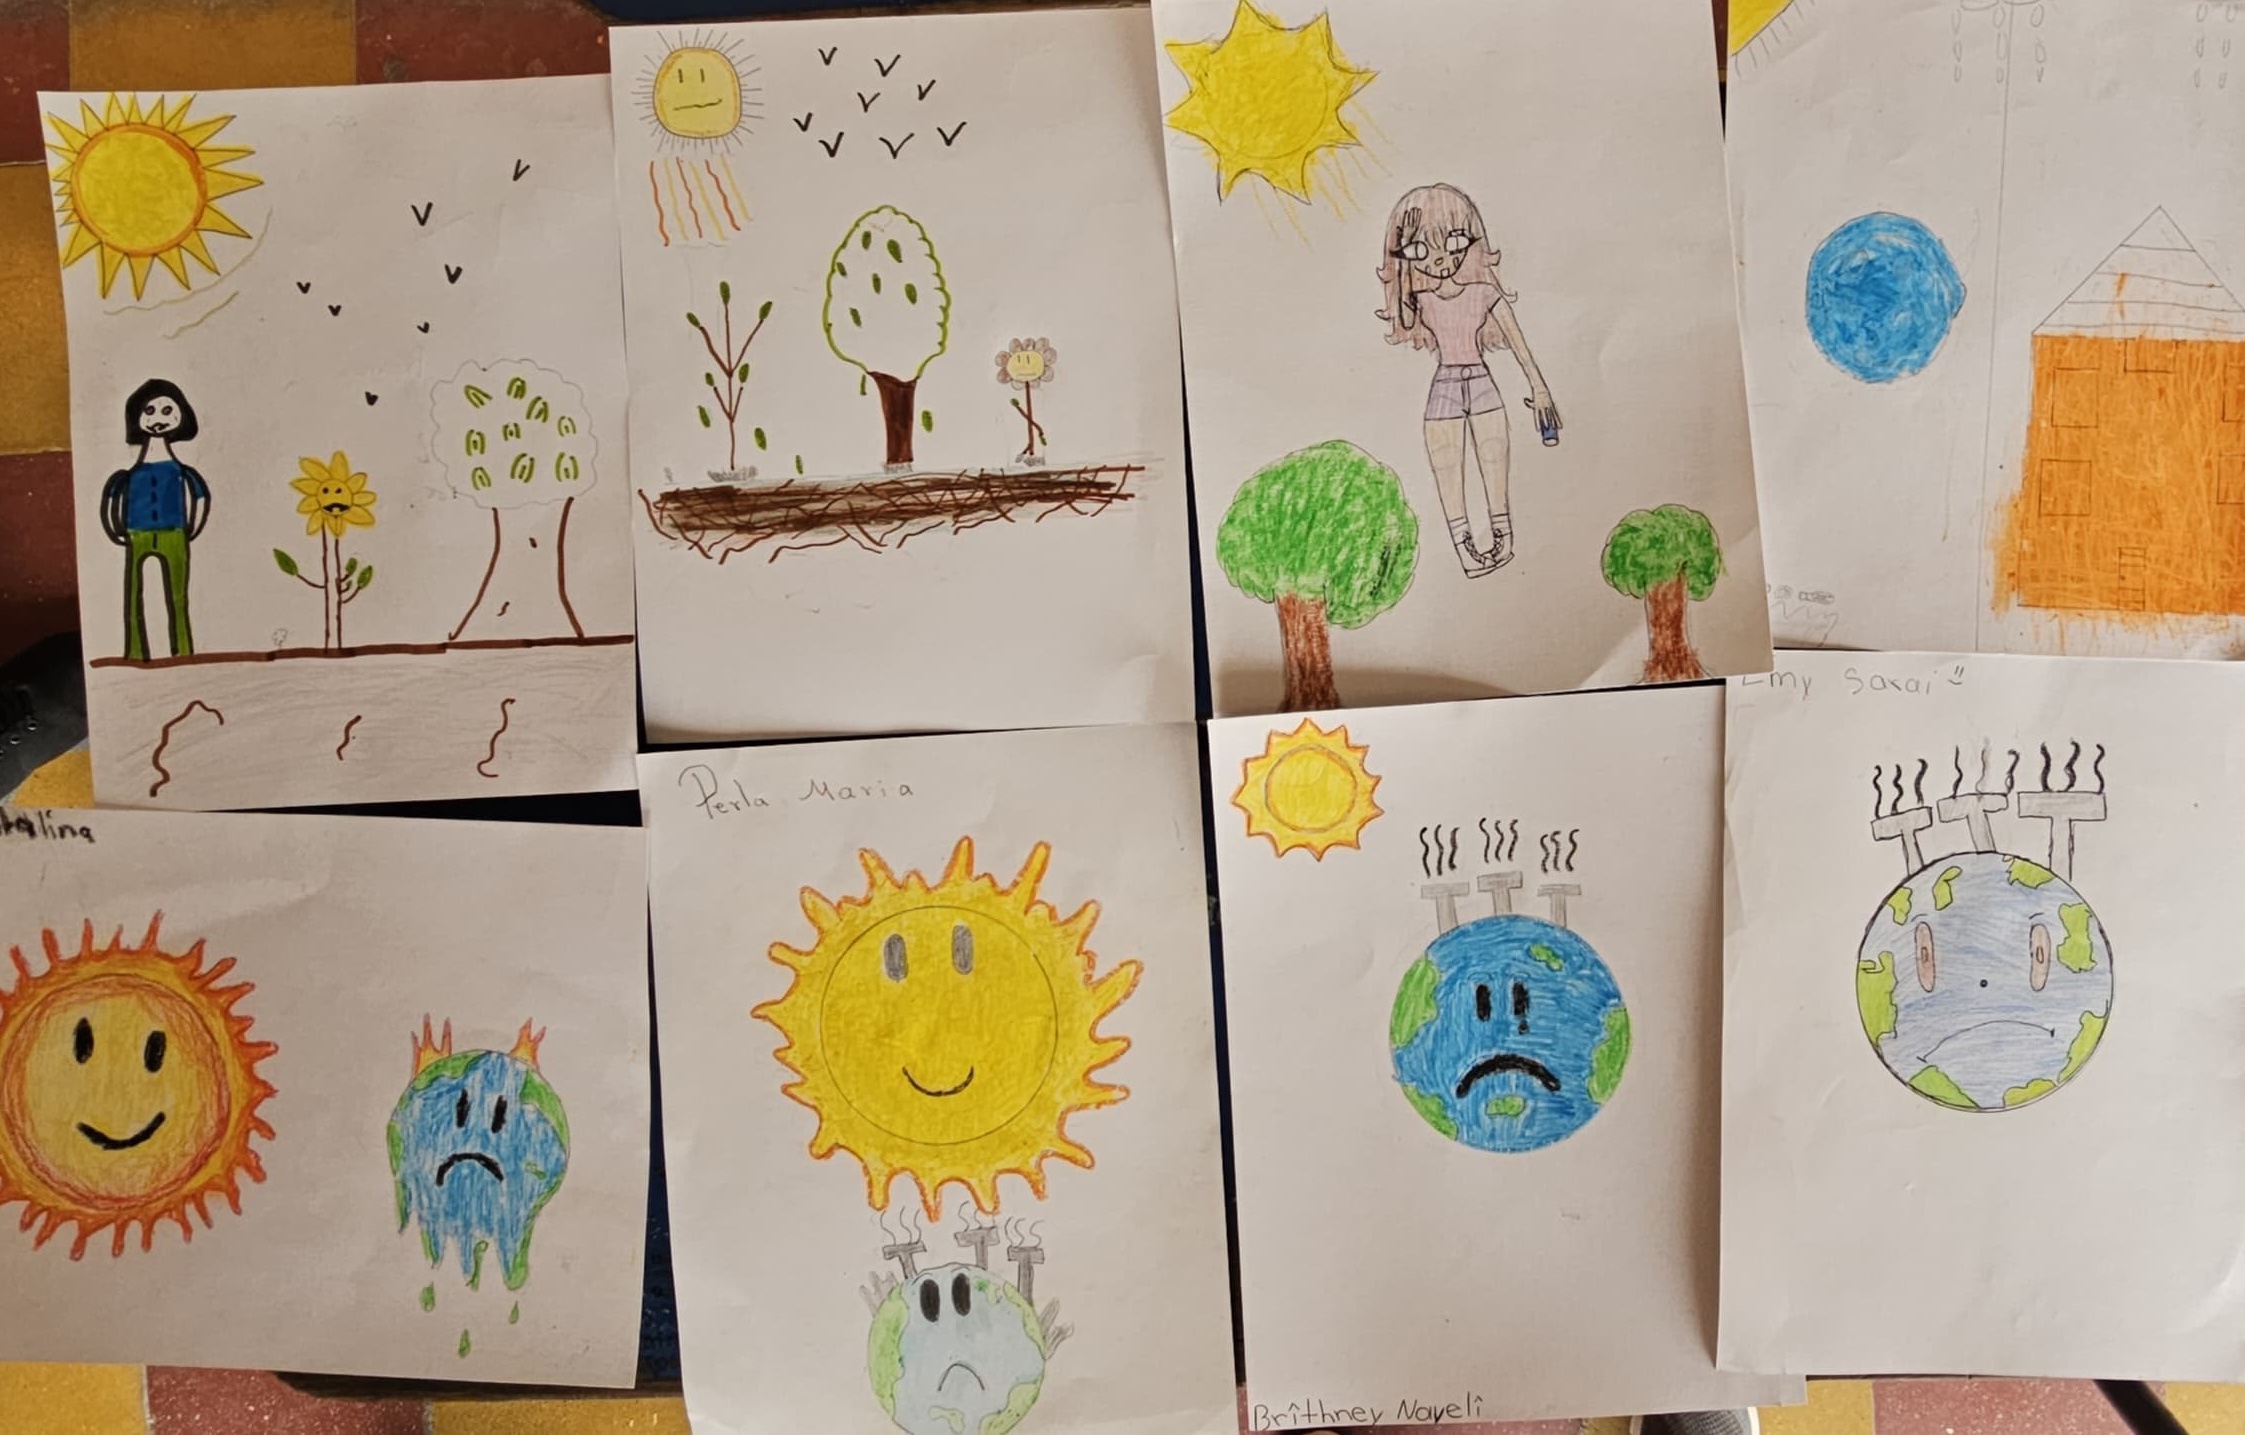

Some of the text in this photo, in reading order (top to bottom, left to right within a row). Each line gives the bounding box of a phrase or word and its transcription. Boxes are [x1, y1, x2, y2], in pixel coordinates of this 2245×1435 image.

[1844, 667, 1937, 696] Sarai
[678, 763, 914, 820] Perla Maria
